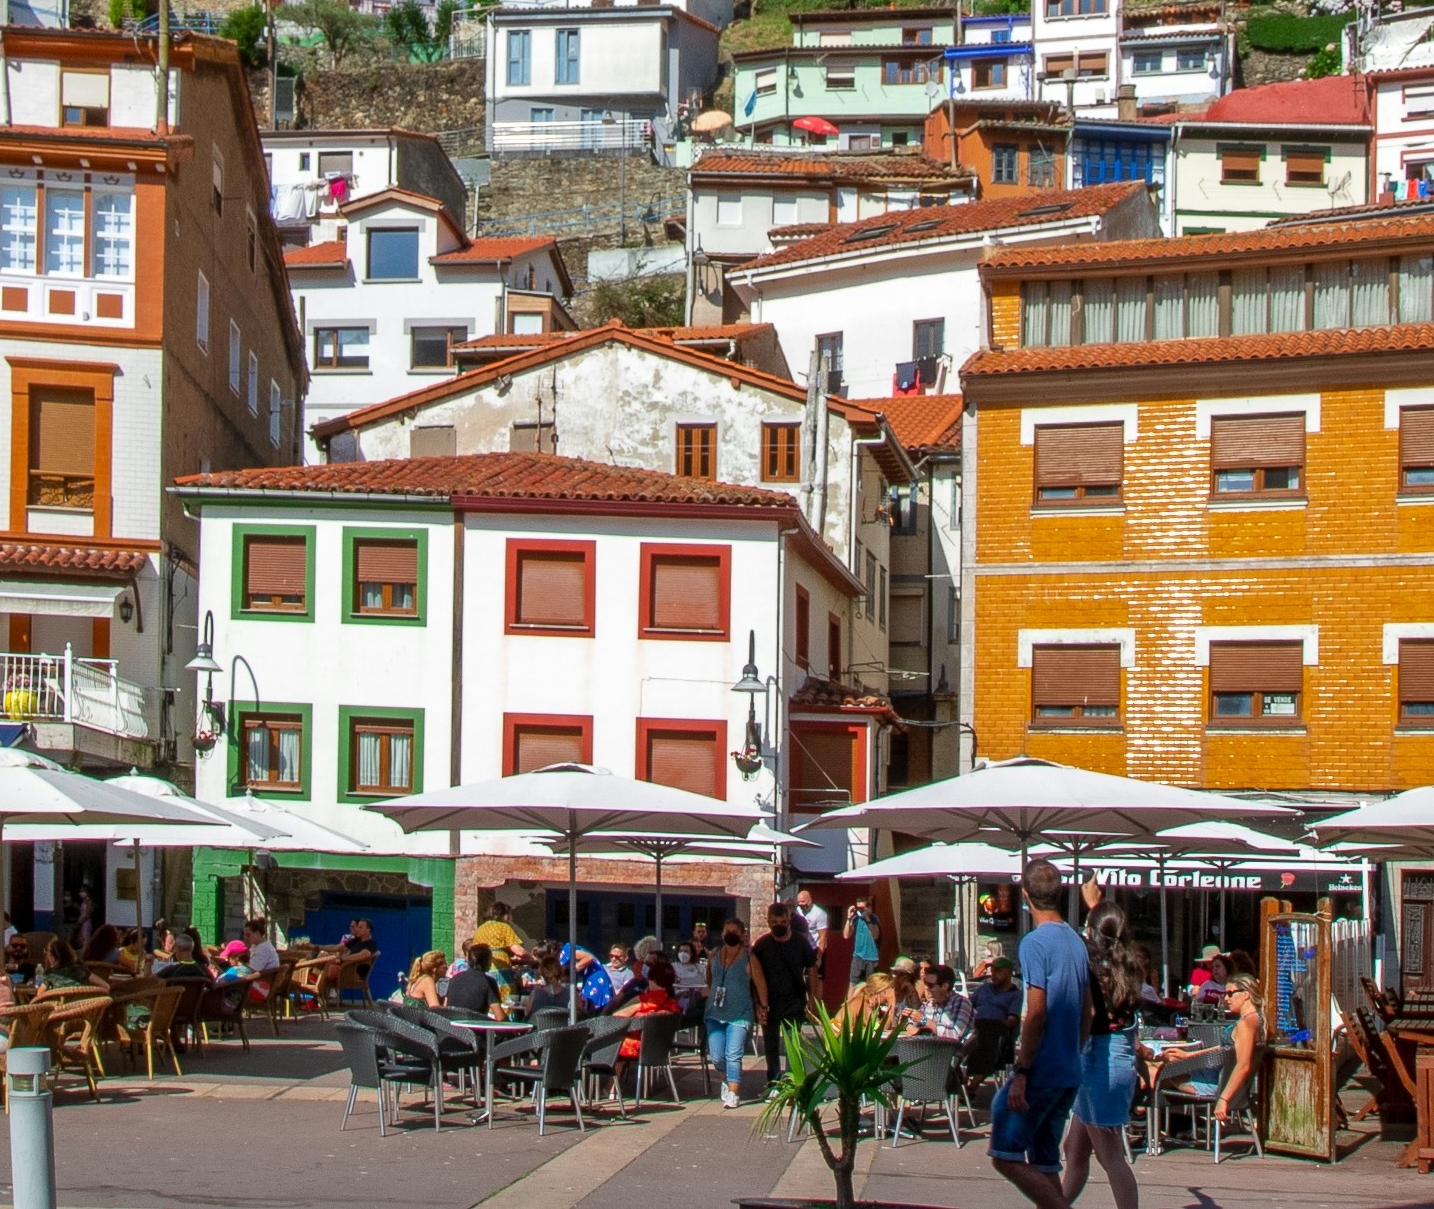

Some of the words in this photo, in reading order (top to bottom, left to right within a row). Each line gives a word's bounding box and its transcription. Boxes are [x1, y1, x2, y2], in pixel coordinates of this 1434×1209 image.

[1092, 867, 1142, 886] Vito
[1149, 868, 1261, 888] Corleone
[1328, 883, 1363, 892] Heineken
